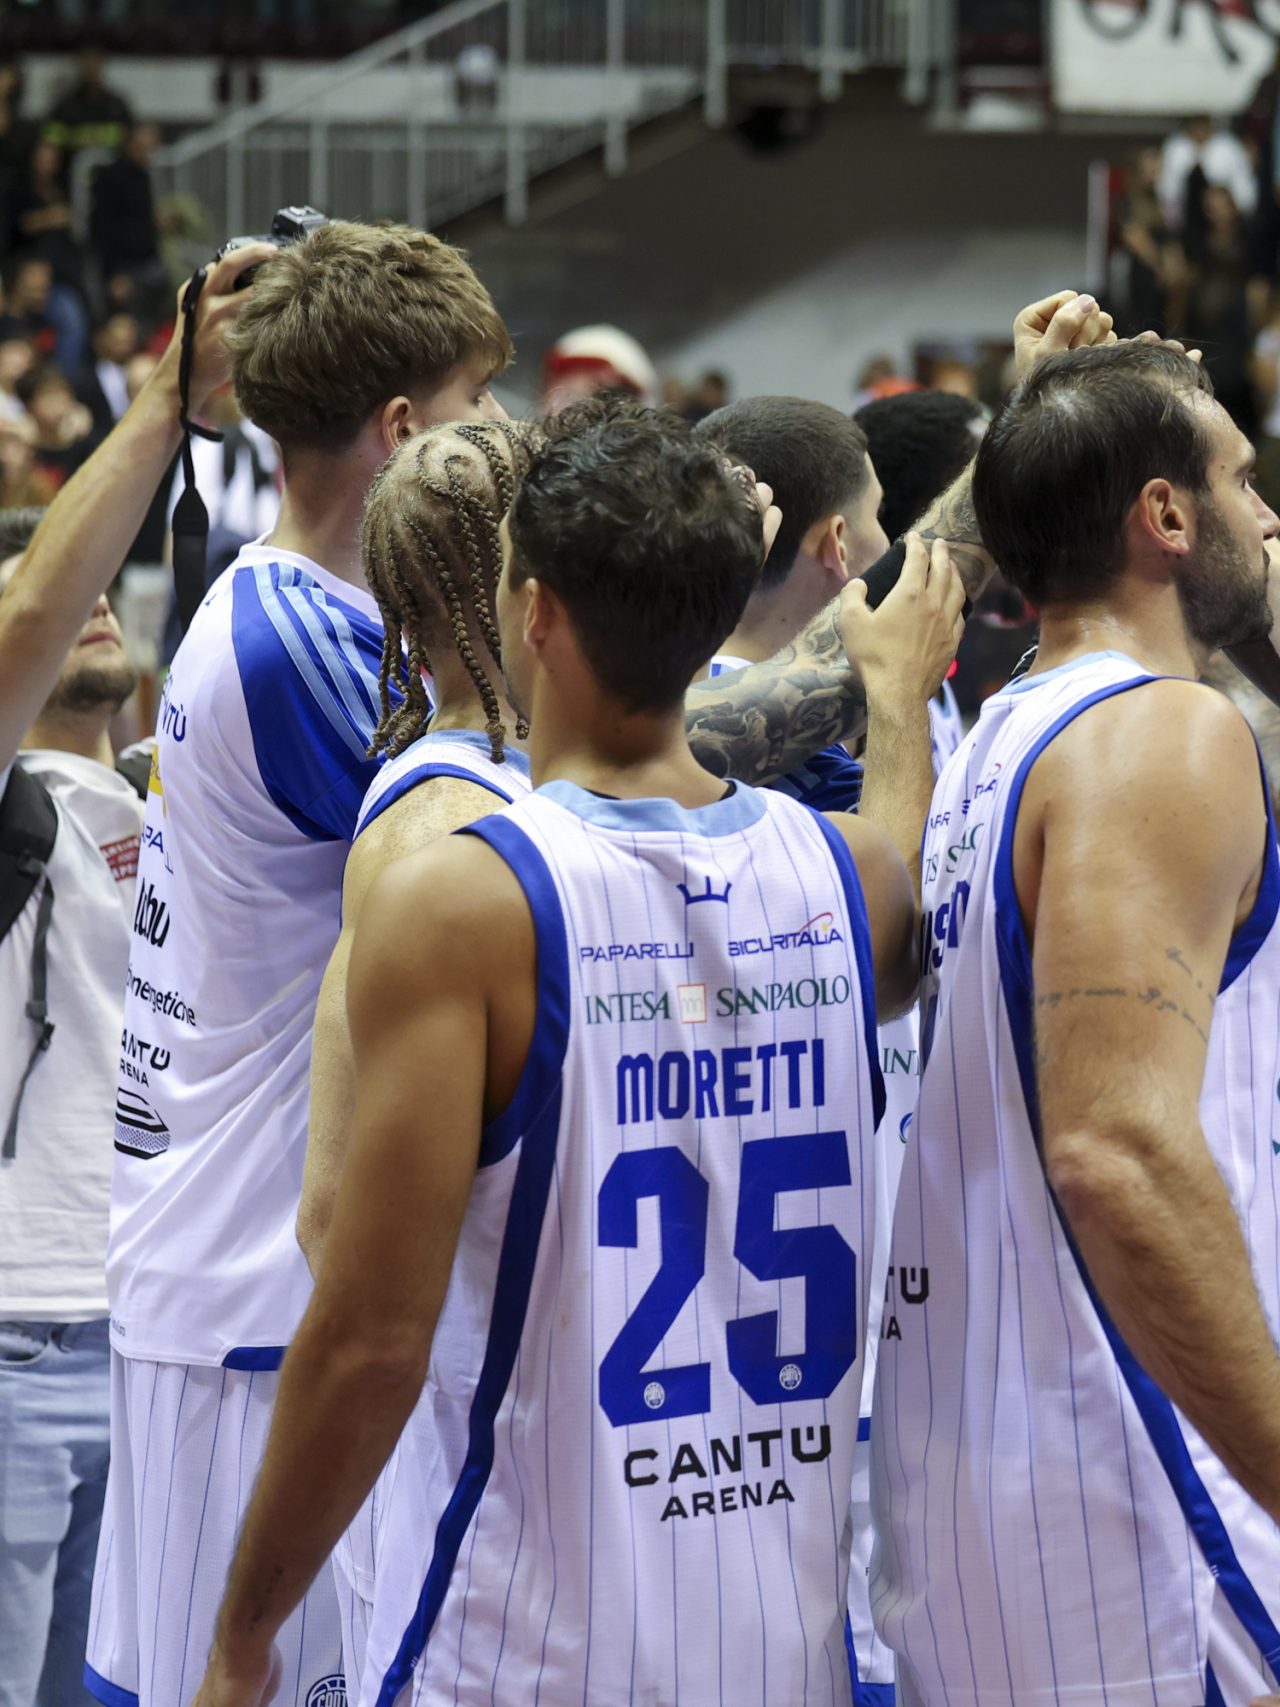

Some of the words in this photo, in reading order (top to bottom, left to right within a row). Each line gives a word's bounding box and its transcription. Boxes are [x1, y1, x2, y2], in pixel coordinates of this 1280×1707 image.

[581, 942, 694, 962] PAPARELLI
[727, 928, 844, 957] SICURITALIA
[585, 991, 672, 1024] INTESA
[716, 975, 850, 1017] SANPAOLO
[120, 1058, 149, 1088] RENA
[617, 1038, 825, 1126] MORETTI
[597, 1130, 857, 1428] 25
[660, 1479, 795, 1522] ARENA
